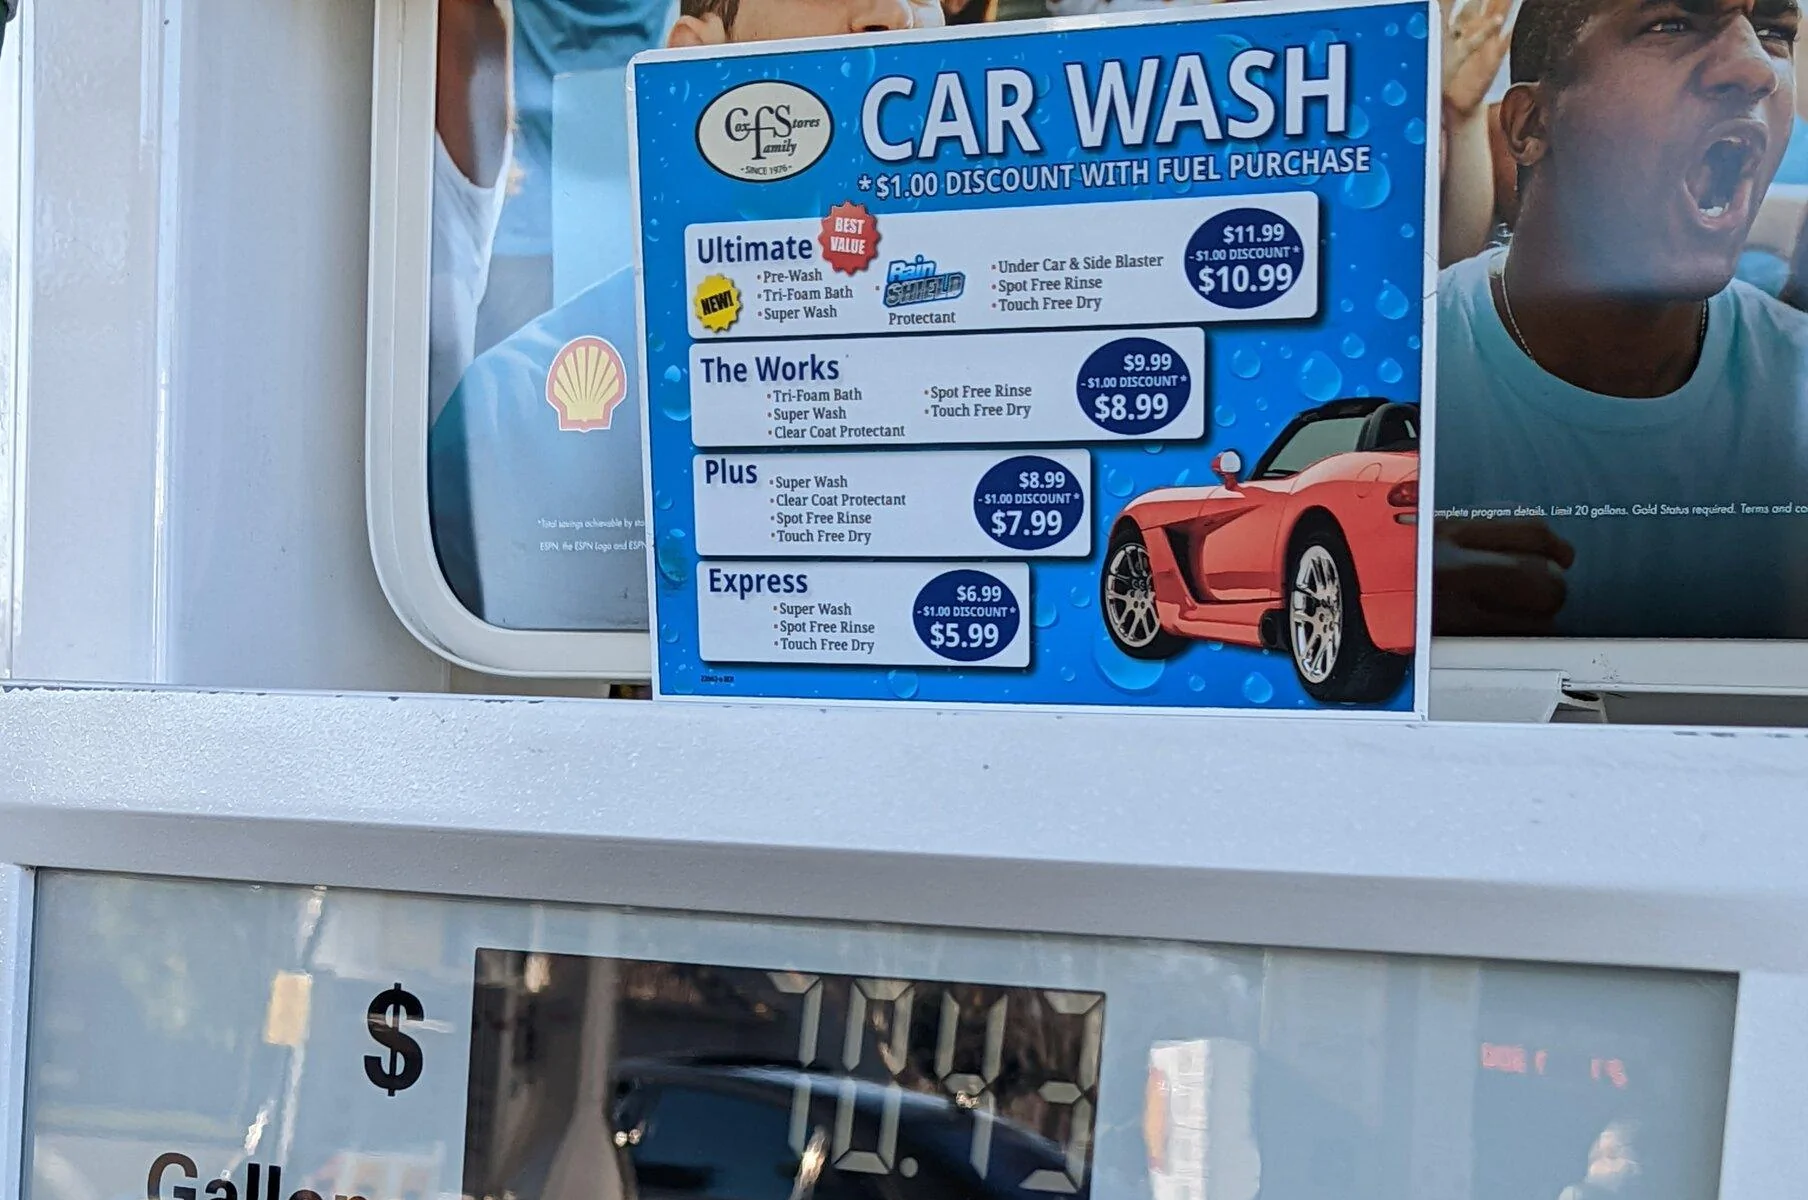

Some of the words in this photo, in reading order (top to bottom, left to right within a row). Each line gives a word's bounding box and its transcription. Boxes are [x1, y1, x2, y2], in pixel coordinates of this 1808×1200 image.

[862, 68, 1041, 161] CAR
[1065, 43, 1349, 148] WASH
[945, 164, 1073, 195] DISCOUNT
[1080, 160, 1147, 187] WITH
[1158, 155, 1221, 182] FUEL
[1230, 146, 1370, 179] PURCHASE
[834, 217, 866, 235] BEST
[1222, 223, 1285, 245] $11.99
[697, 235, 813, 264] Ultimate
[830, 236, 867, 255] VALUE
[888, 255, 936, 282] Rain
[998, 259, 1040, 274] Under
[1043, 258, 1067, 272] Car
[1069, 257, 1080, 270] &
[1083, 255, 1112, 270] Side
[1115, 254, 1164, 268] Blaster
[763, 268, 823, 283] Pre-Wash
[1198, 263, 1293, 295] $10.99
[764, 288, 821, 301] Tri-Foam
[824, 286, 853, 300] Bath
[884, 272, 965, 307] SHIELD
[998, 279, 1027, 296] Spot
[1031, 277, 1061, 291] Free
[1064, 276, 1103, 290] Rinse
[700, 289, 735, 317] NEW!
[998, 297, 1038, 312] Touch
[1043, 296, 1073, 310] Free
[1076, 295, 1103, 312] Dry
[765, 308, 801, 323] Super
[803, 305, 838, 319] Wash
[888, 311, 956, 325] Protectant
[700, 356, 747, 383] The
[755, 353, 840, 382] Works
[1123, 353, 1172, 372] $9.99
[773, 389, 830, 402] Tri-Foam
[834, 387, 862, 401] Bath
[930, 386, 958, 402] Spot
[962, 385, 991, 398] Free
[995, 384, 1032, 397] Rinse
[774, 408, 810, 423] Super
[813, 406, 847, 420] Wash
[930, 404, 970, 418] Touch
[974, 404, 1003, 417] Free
[1007, 403, 1031, 419] Dry
[1094, 393, 1169, 422] $8.99
[774, 426, 806, 439] Clear
[809, 426, 837, 439] Coat
[839, 425, 905, 438] Protectant
[705, 458, 758, 485] Plus
[1019, 471, 1066, 489] $8.99
[775, 476, 811, 492] Super
[814, 475, 848, 488] Wash
[776, 493, 809, 506] Clear
[811, 494, 838, 506] Coat
[841, 493, 906, 506] Protectant
[776, 511, 804, 527] Spot
[806, 511, 834, 524] Free
[836, 511, 872, 524] Rinse
[1471, 507, 1510, 519] program
[1551, 505, 1572, 516] Limit
[1575, 505, 1589, 516] 20
[1591, 505, 1629, 519] gallons.
[1632, 504, 1657, 515] Gold
[1660, 503, 1689, 515] Status
[1741, 503, 1769, 514] Terms
[1772, 502, 1792, 514] and
[991, 509, 1063, 538] $7.99
[574, 541, 593, 551] ESPN
[776, 529, 814, 543] Touch
[817, 529, 845, 542] Free
[848, 530, 872, 546] Dry
[708, 567, 808, 599] Express
[956, 585, 1002, 603] $6.99
[780, 602, 815, 618] Super
[818, 602, 852, 616] Wash
[780, 620, 806, 636] Spot
[809, 620, 837, 633] Free
[840, 620, 875, 634] Rinse
[930, 620, 999, 649] $5.99
[780, 637, 817, 650] Touch
[819, 638, 848, 651] Free
[851, 639, 875, 655] Dry
[364, 981, 426, 1098] $
